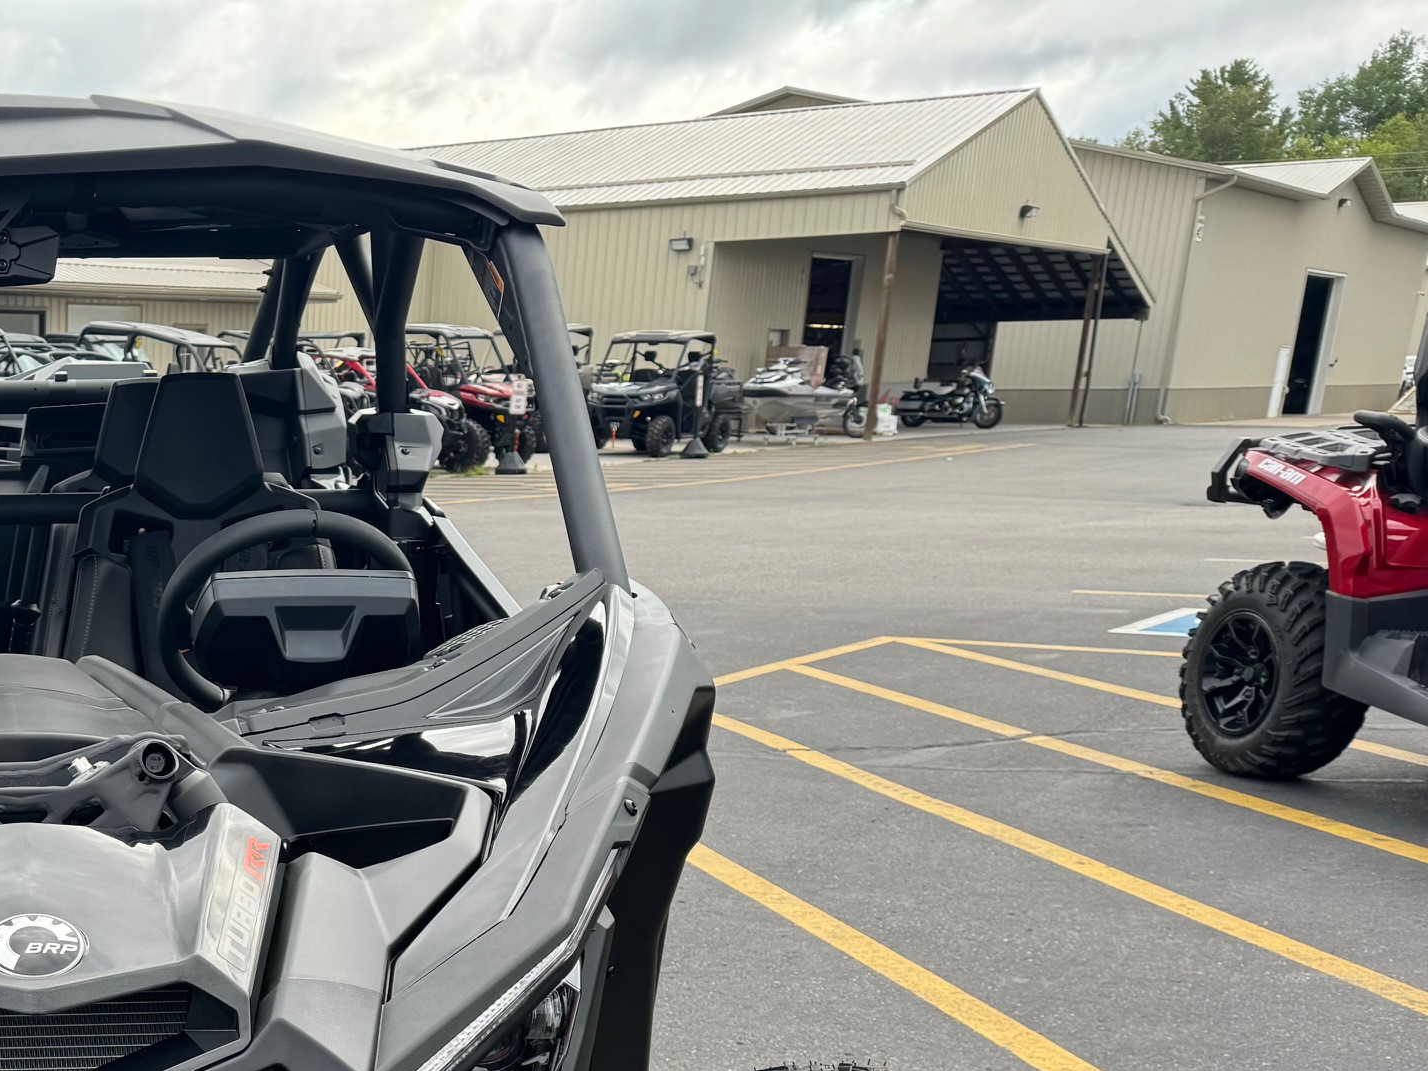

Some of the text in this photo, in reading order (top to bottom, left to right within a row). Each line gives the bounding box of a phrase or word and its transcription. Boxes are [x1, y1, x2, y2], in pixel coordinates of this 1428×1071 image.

[1257, 458, 1307, 485] can-am
[221, 835, 270, 962] TURBO RR
[25, 942, 79, 955] BRP
